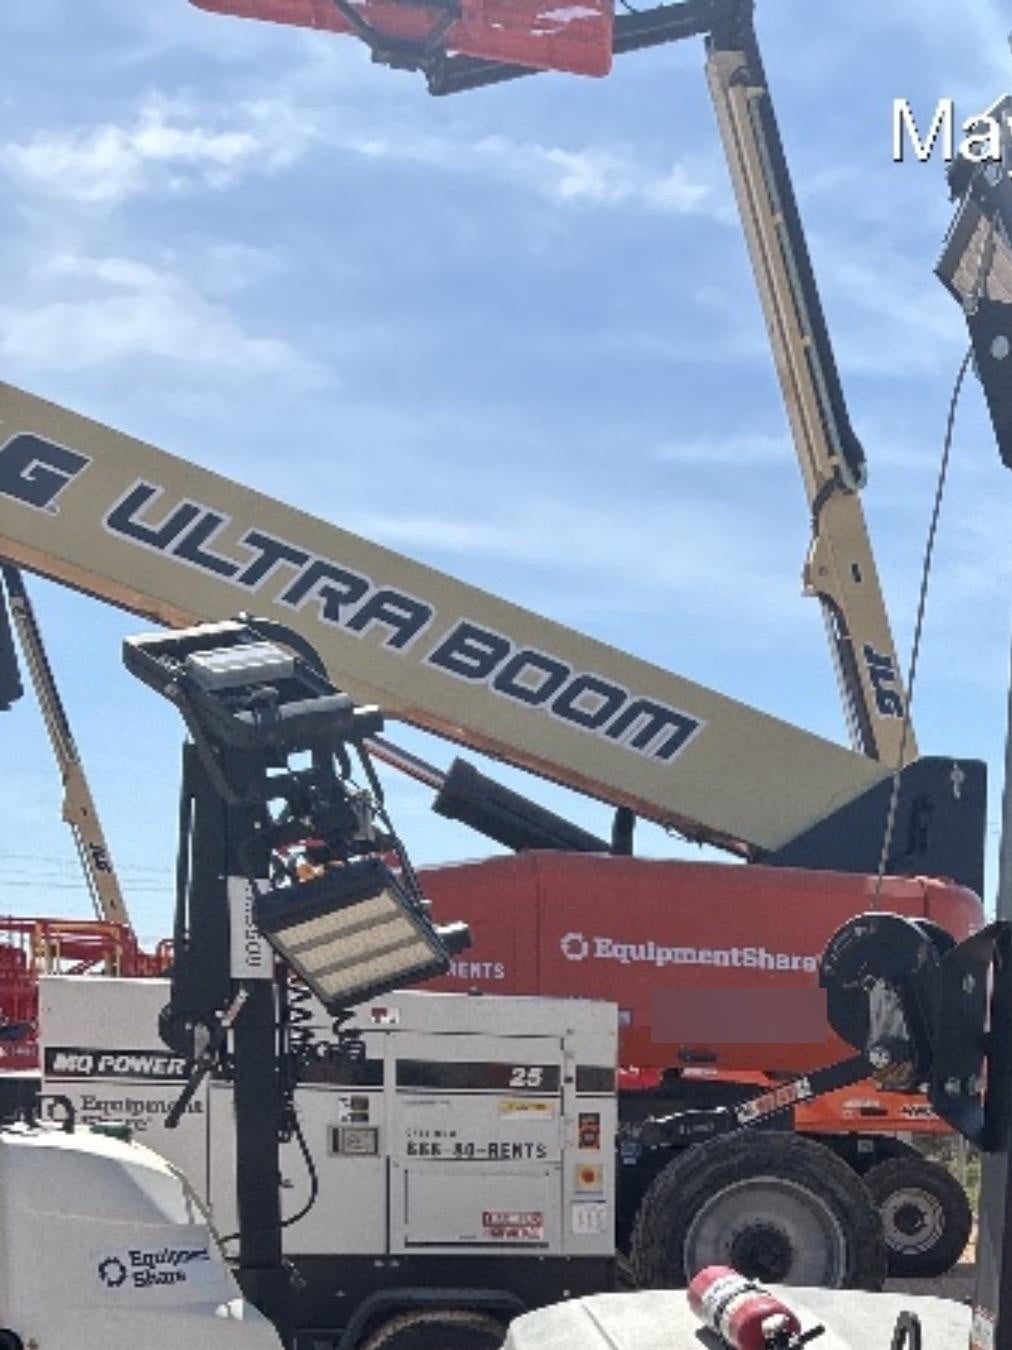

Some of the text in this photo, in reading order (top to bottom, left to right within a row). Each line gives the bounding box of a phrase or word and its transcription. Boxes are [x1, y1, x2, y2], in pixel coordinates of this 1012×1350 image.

[102, 478, 434, 655] ULTRA
[425, 618, 709, 766] BOOM
[592, 936, 818, 973] EquipmentShare
[97, 1053, 188, 1076] POWER
[508, 1066, 544, 1088] 25
[79, 1094, 206, 1117] Equipmt
